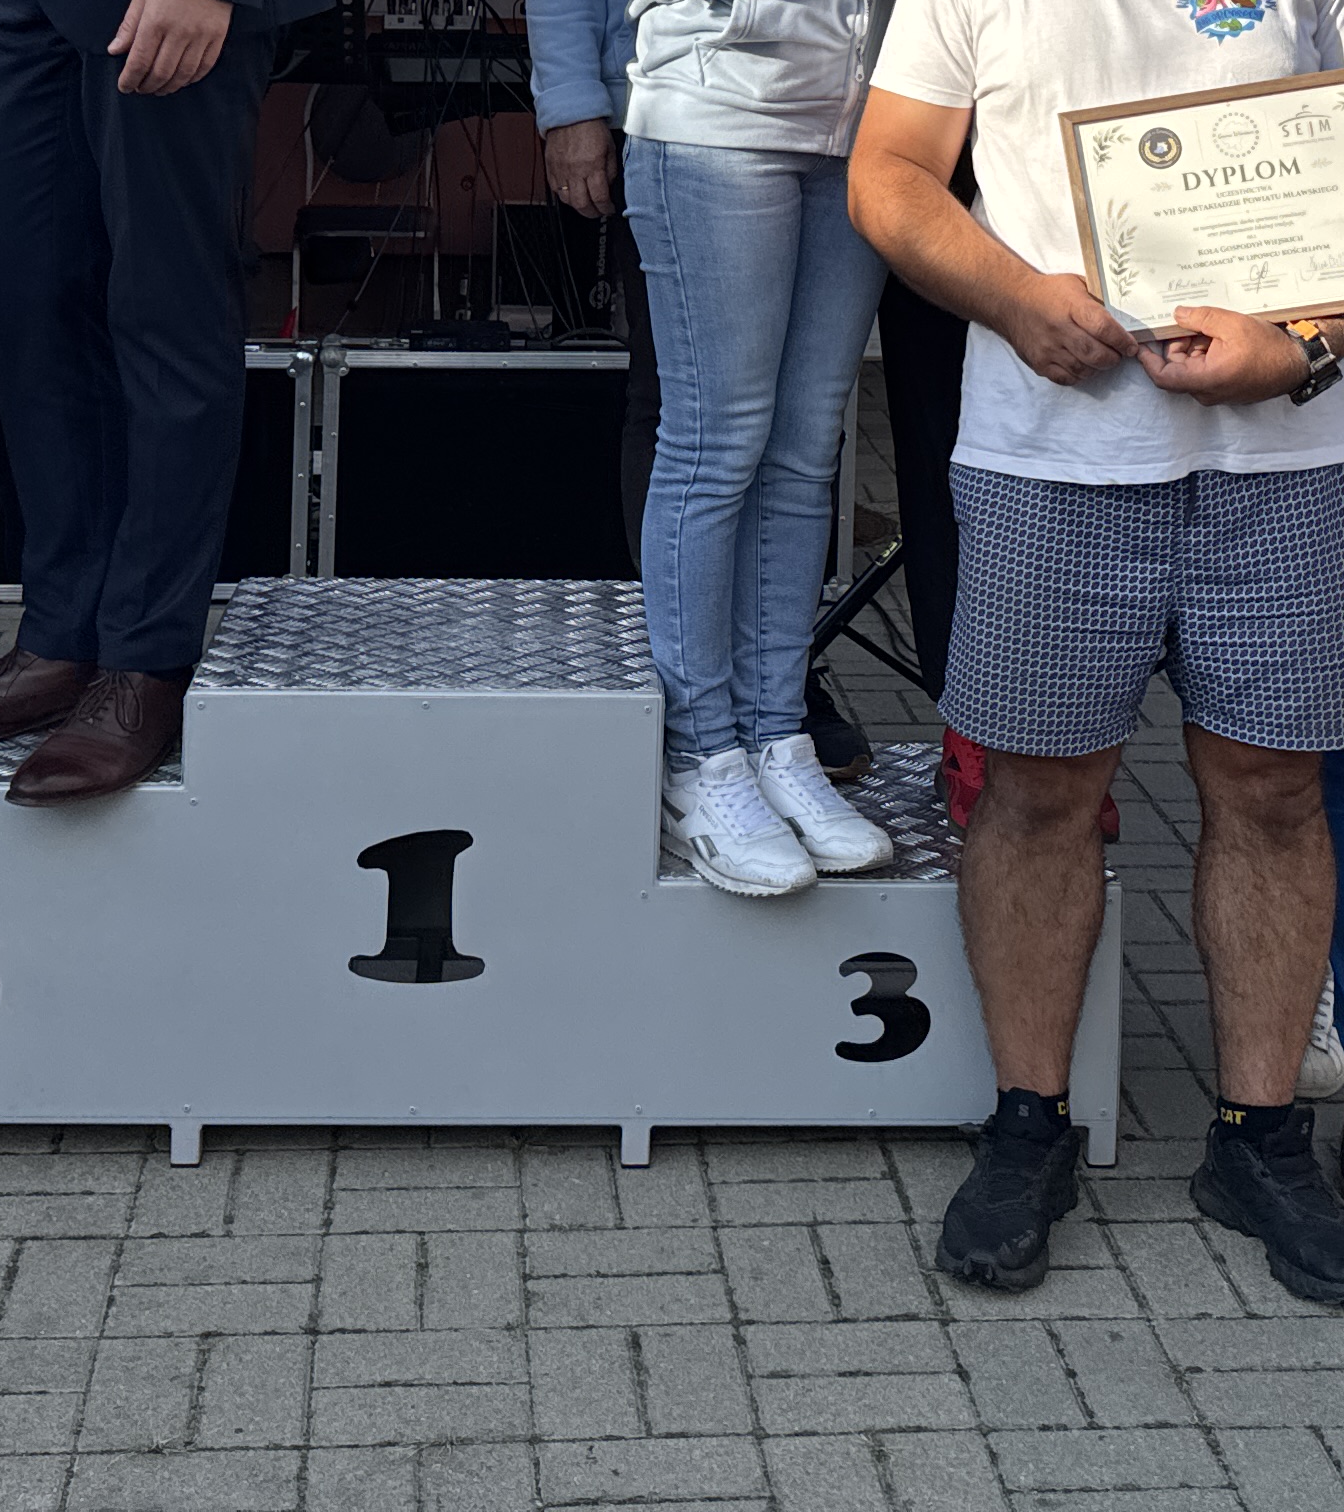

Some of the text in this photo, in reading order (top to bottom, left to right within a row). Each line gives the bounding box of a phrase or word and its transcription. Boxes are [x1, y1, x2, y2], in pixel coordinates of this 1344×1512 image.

[1281, 118, 1332, 138] SEJM
[1182, 156, 1302, 191] DYPLOM
[347, 829, 485, 984] 1
[835, 951, 931, 1062] 3
[1220, 1107, 1247, 1125] CAT
